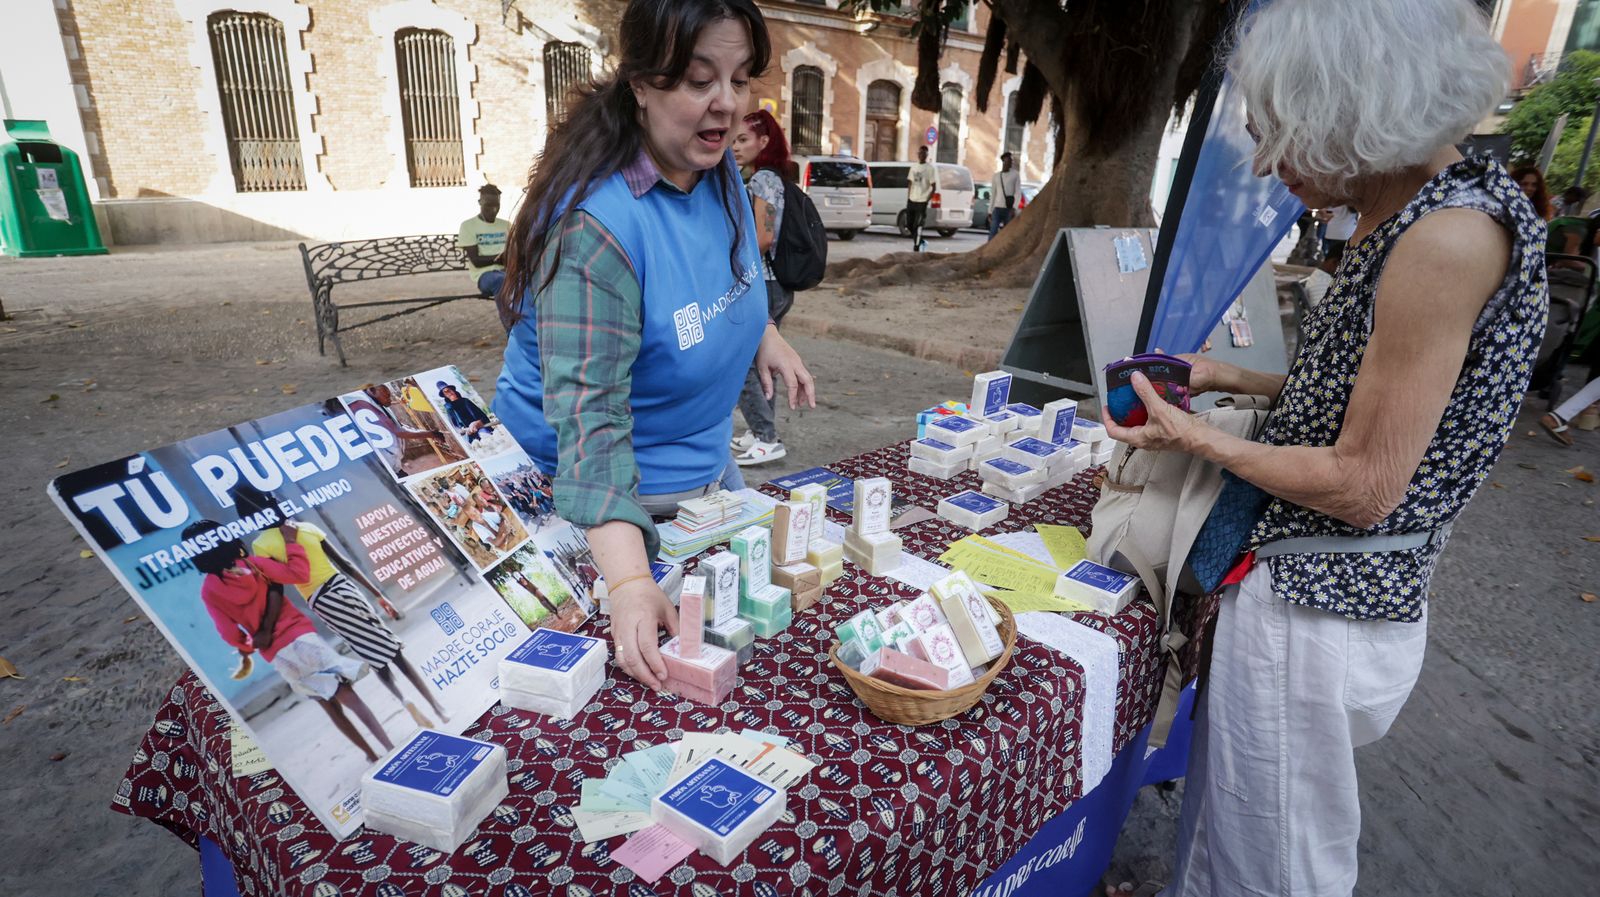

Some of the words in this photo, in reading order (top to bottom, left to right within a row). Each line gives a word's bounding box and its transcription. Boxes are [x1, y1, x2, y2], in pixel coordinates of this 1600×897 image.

[72, 455, 190, 545] TÚ
[191, 408, 394, 508] PUEDES
[138, 507, 280, 574] TRANSFORMAR
[278, 496, 304, 518] EL
[301, 478, 353, 508] MUNDO
[360, 514, 414, 548] NUESTROS
[368, 526, 428, 564] PROYECTOS
[373, 541, 436, 583] EDUCATIVOS
[433, 536, 444, 549] Y
[397, 573, 416, 590] DE
[415, 556, 445, 581] AGUA!
[420, 639, 464, 677] MADRE
[461, 608, 505, 645] CORAJE
[431, 650, 480, 691] HAZTE
[475, 622, 517, 657] SOCI@
[1034, 816, 1087, 873] CORAJE
